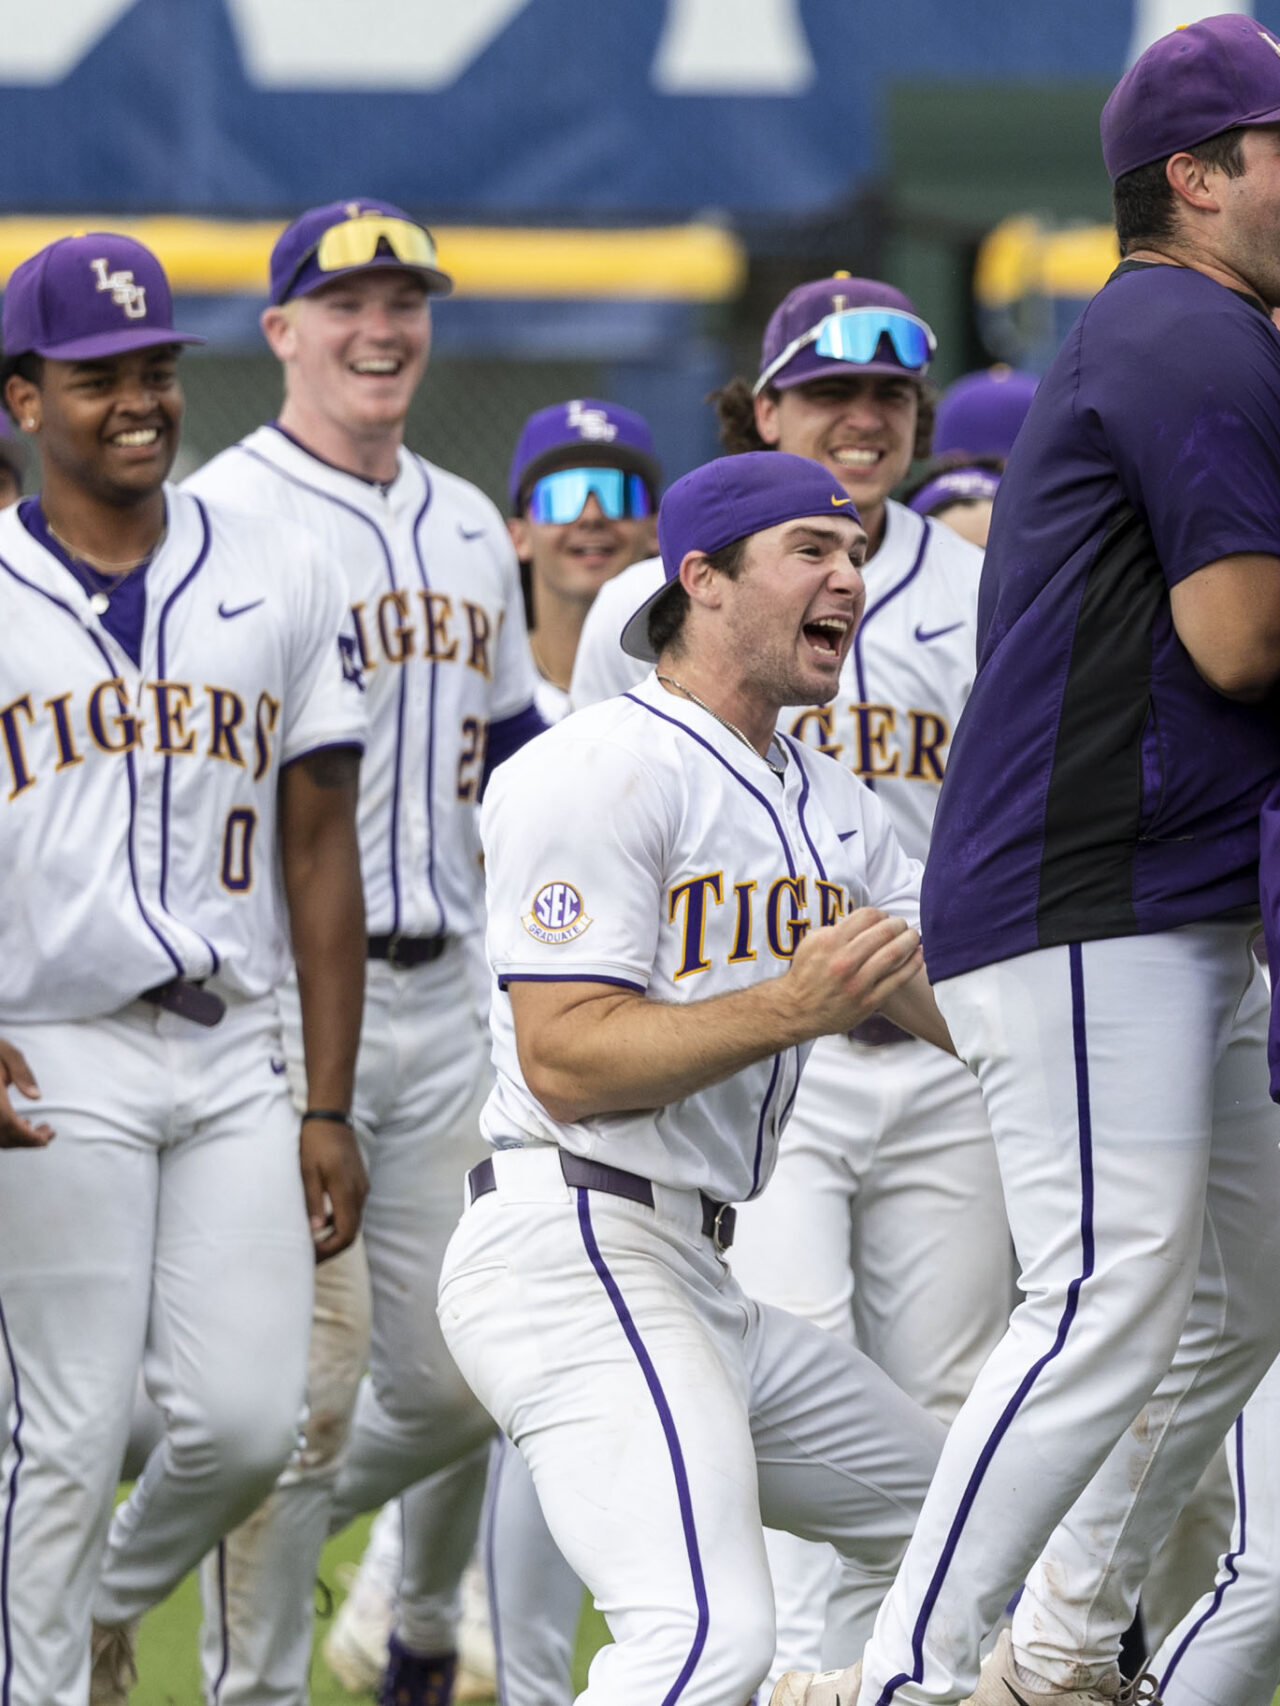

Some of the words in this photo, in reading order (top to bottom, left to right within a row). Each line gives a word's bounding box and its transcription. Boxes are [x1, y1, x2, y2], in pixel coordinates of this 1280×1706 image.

[90, 257, 147, 320] LSU
[351, 585, 505, 682] IGER
[0, 676, 282, 802] TIGERS
[456, 715, 491, 803] 2
[220, 804, 258, 894] 0
[528, 922, 582, 943] GRADUATE
[536, 883, 579, 929] SEC
[668, 869, 854, 982] TIGE
